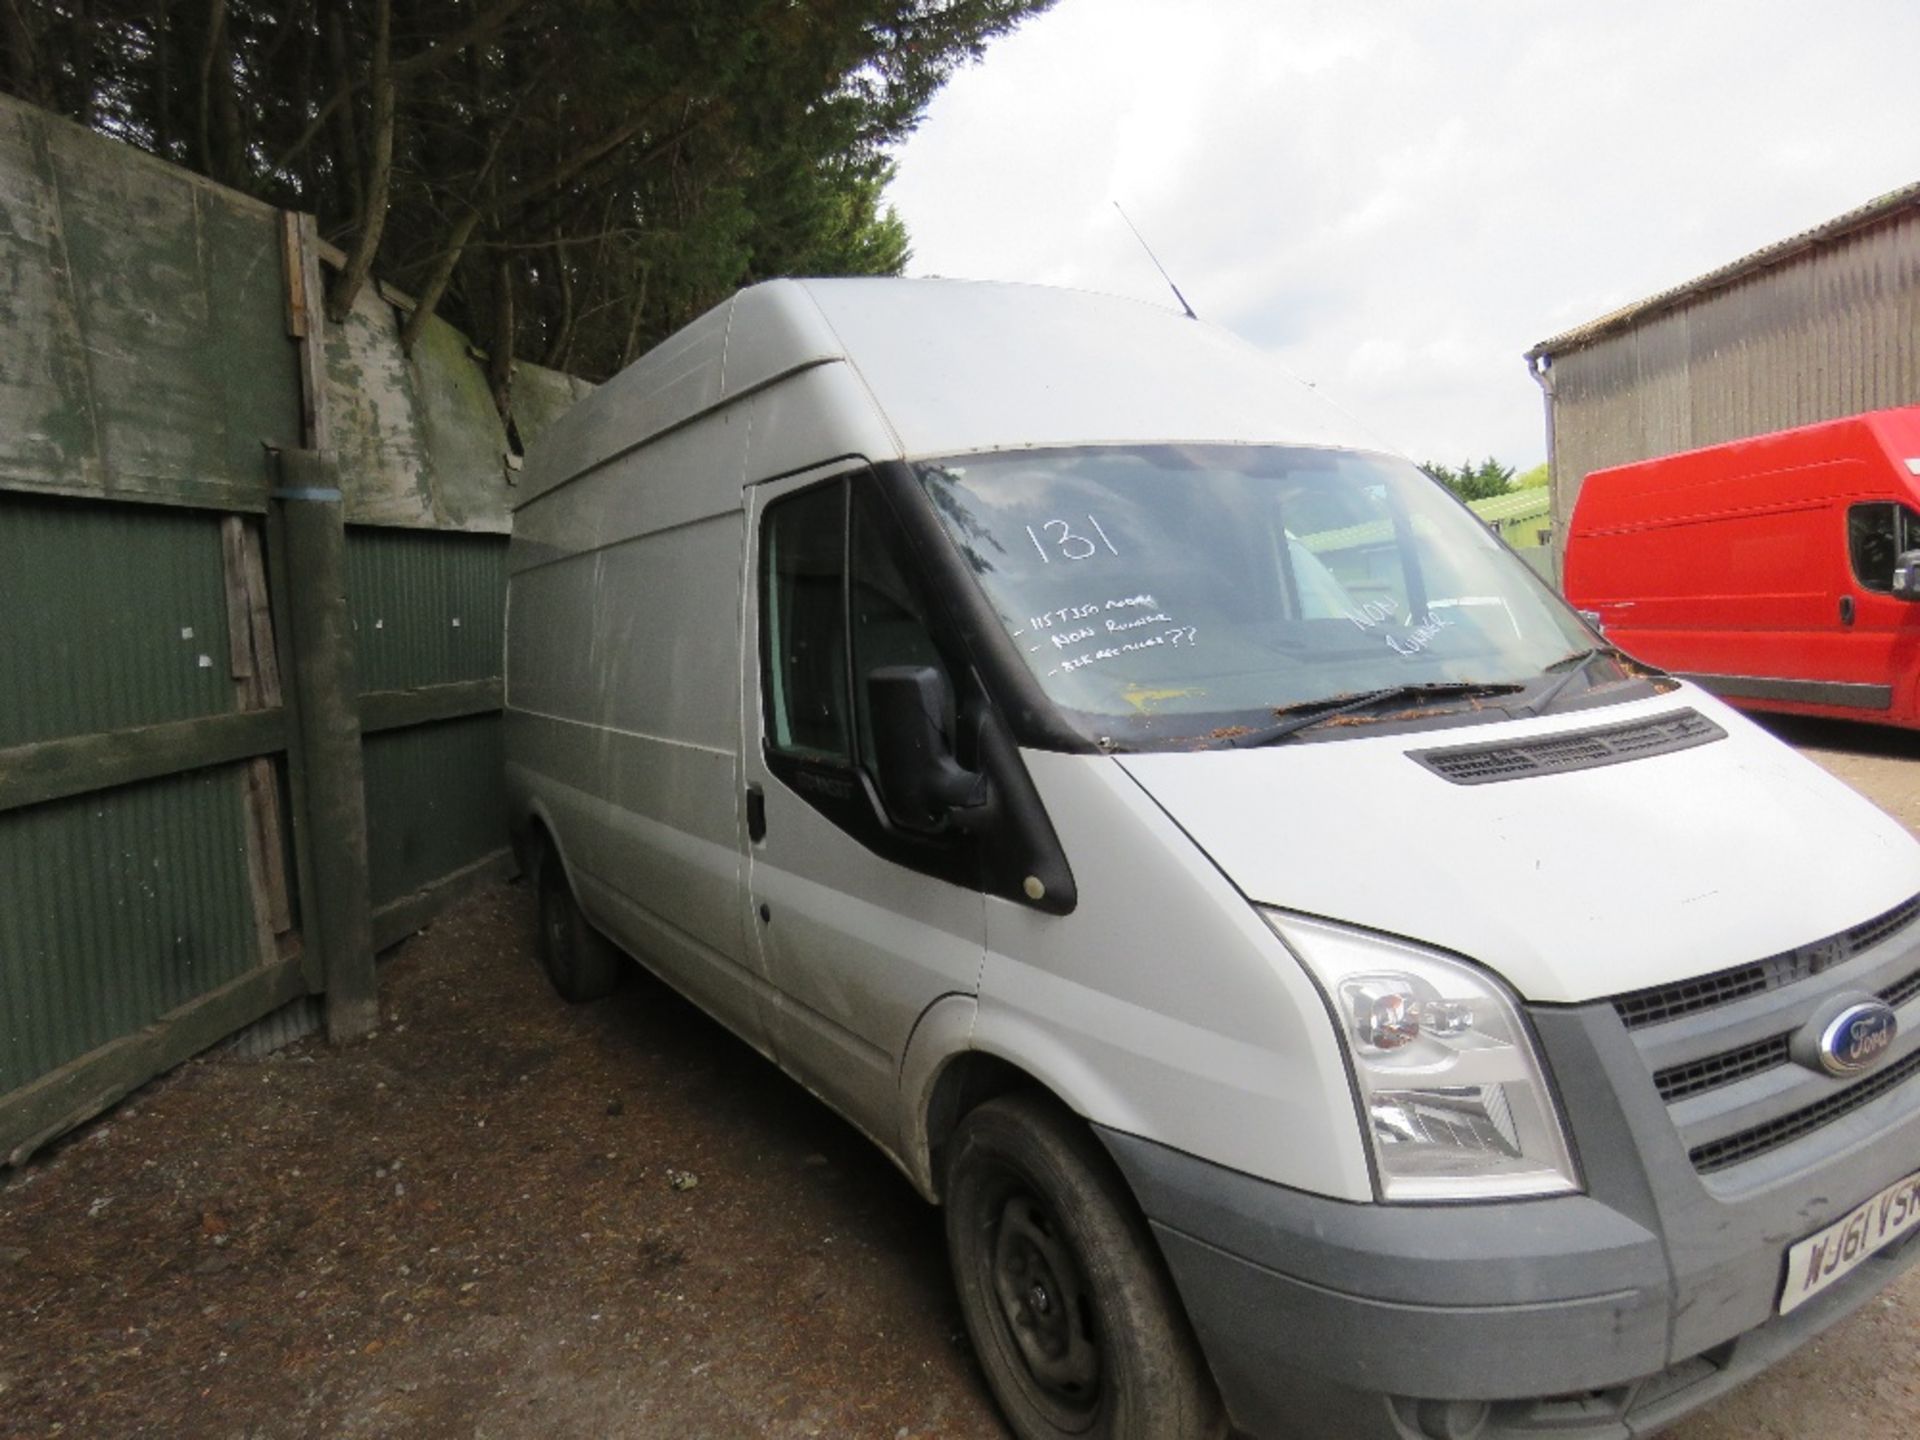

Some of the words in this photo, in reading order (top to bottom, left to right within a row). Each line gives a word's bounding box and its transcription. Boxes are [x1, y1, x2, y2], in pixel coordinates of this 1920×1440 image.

[1026, 514, 1119, 564] 131
[1051, 627, 1095, 649] NON
[1850, 1017, 1888, 1059] Ford
[1803, 1203, 1873, 1291] WJ61
